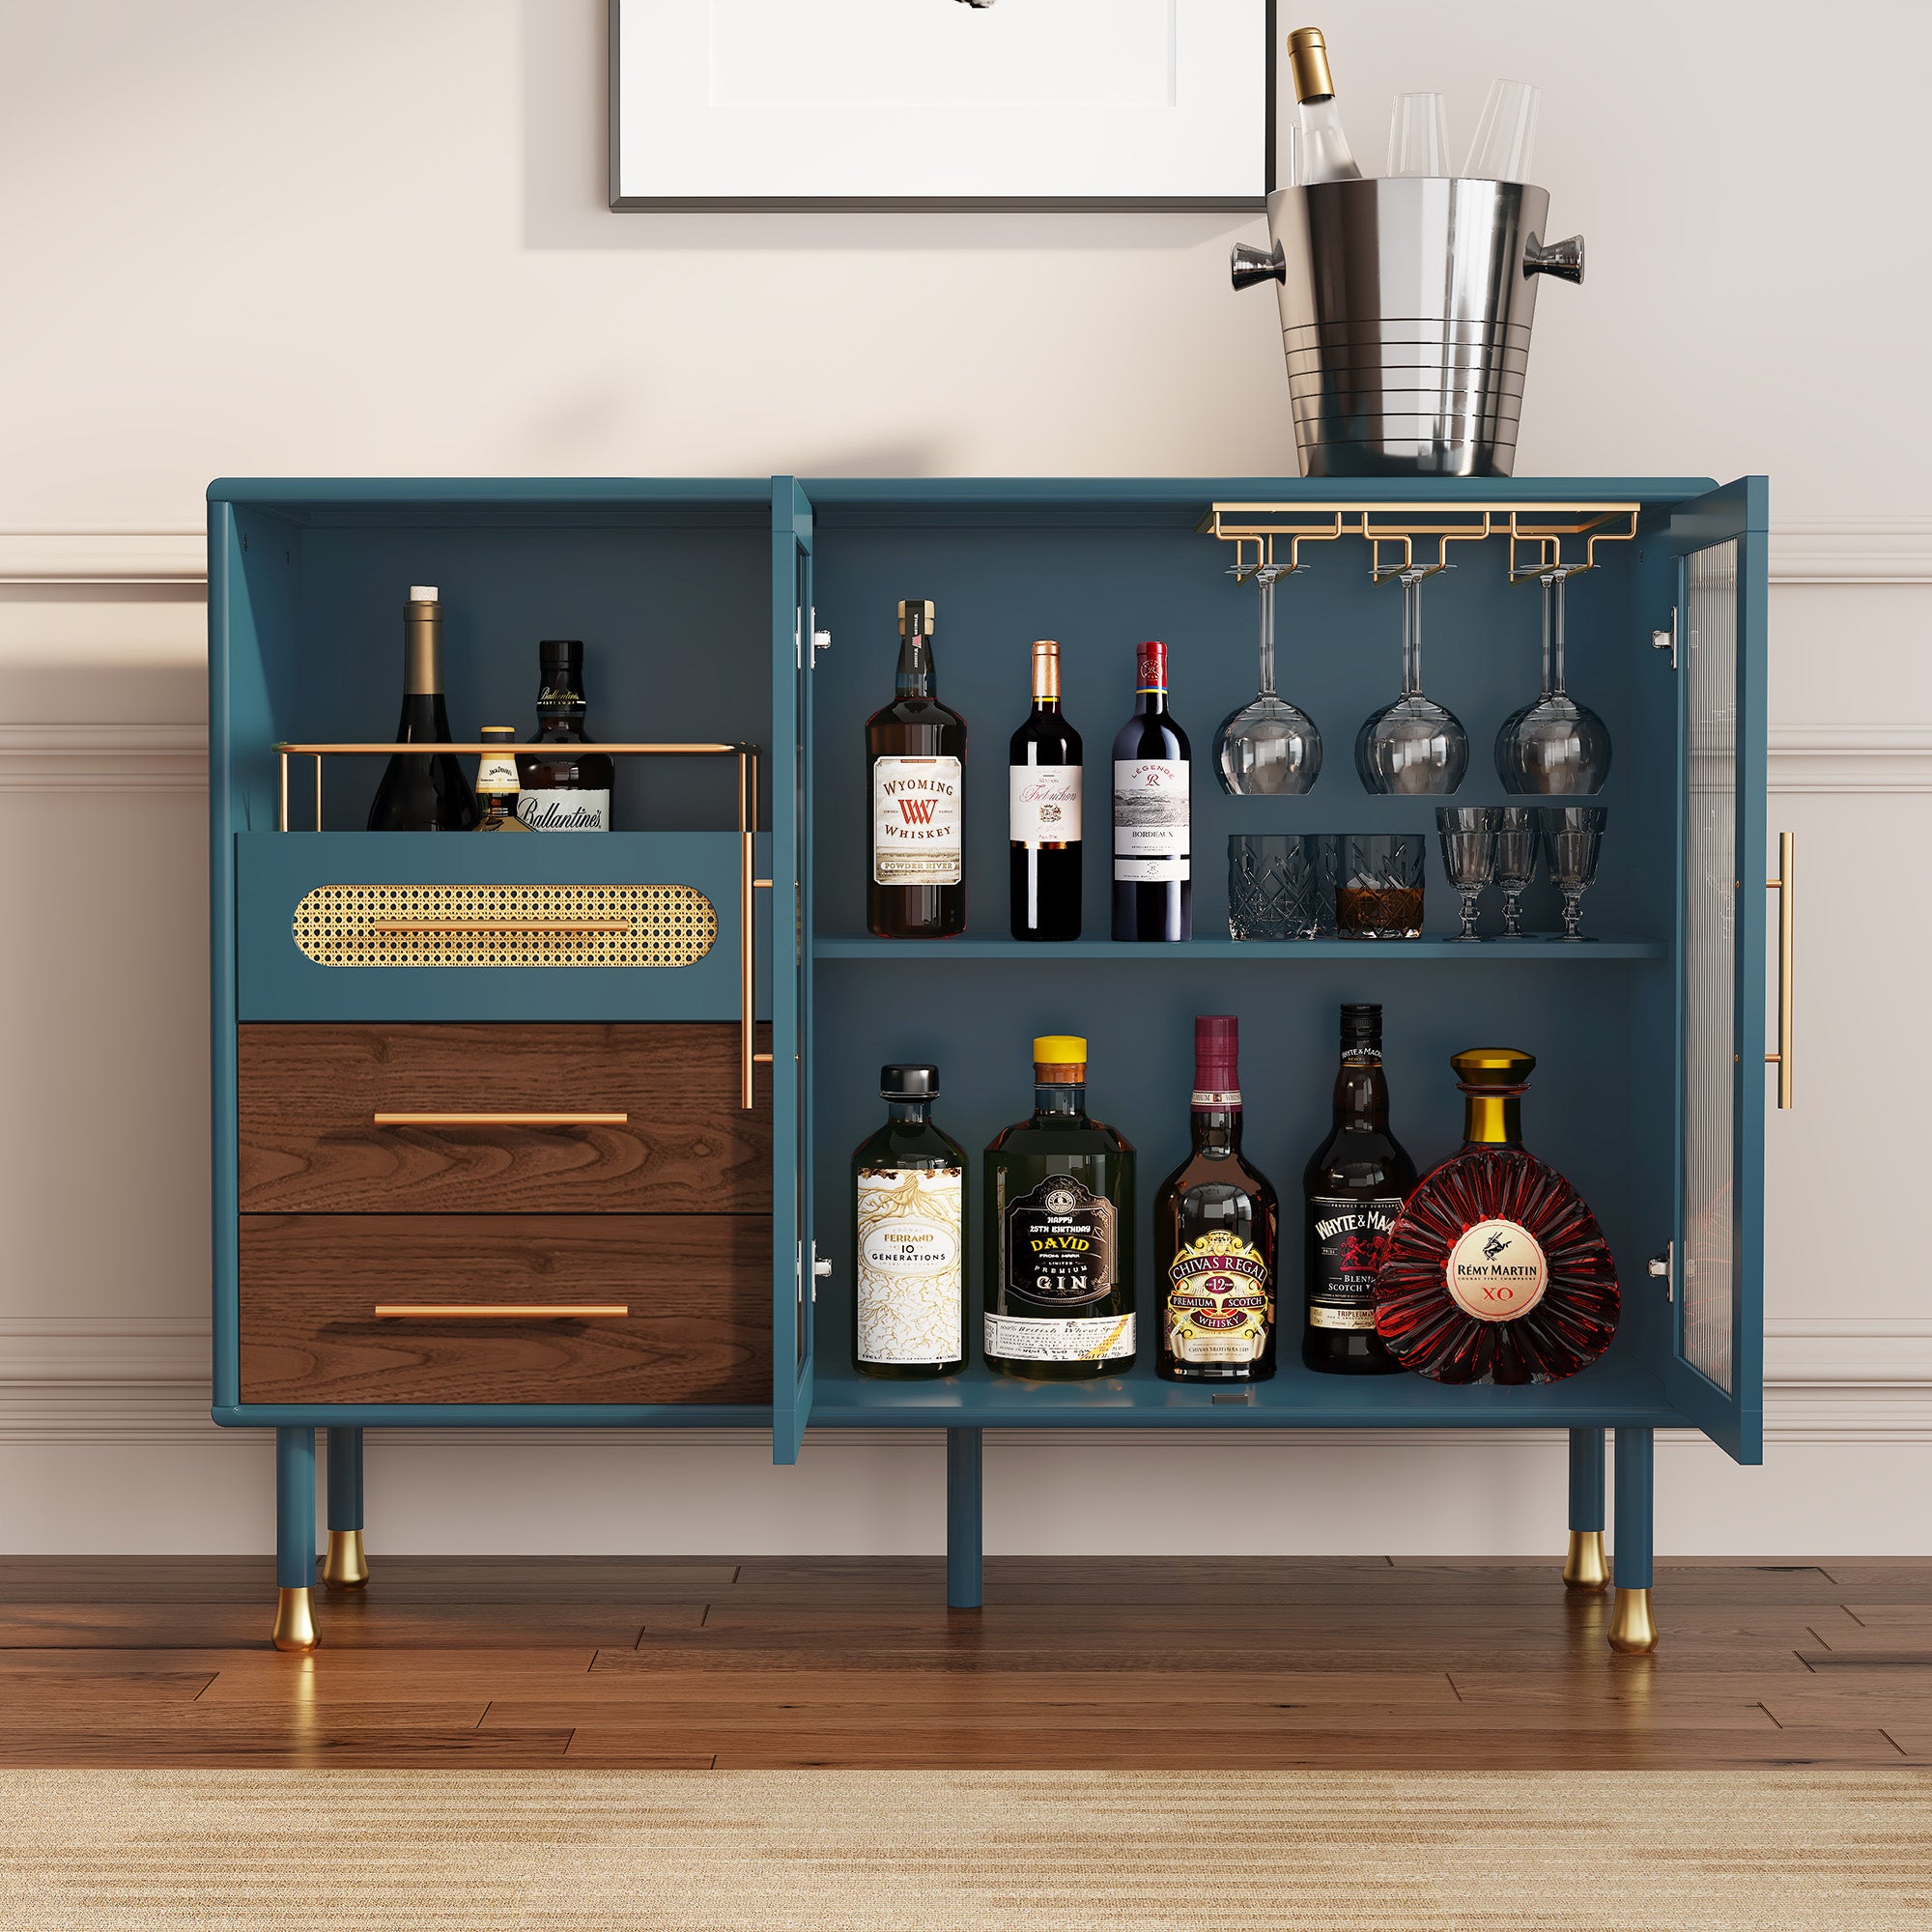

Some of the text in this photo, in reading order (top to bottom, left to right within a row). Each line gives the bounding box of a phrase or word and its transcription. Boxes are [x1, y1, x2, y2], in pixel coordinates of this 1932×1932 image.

[883, 779, 953, 796] WYOMING
[518, 796, 601, 829] Ballantine's
[885, 824, 951, 839] WHISKEY
[1051, 1225, 1091, 1234] BIRTHDAY
[1315, 1214, 1358, 1240] WHYTE
[884, 1234, 934, 1242] FERRAND
[1030, 1236, 1090, 1252] DAVID
[1034, 1264, 1088, 1274] PREMIUM
[1173, 1257, 1264, 1282] CHIVAS REGAL
[1458, 1264, 1537, 1276] RÉMY MARTIN
[1036, 1275, 1088, 1290] GIN
[1211, 1278, 1226, 1291] 12
[1328, 1283, 1363, 1292] SCOTCH
[1173, 1296, 1262, 1307] PREMIUM SCOTCH
[1480, 1287, 1514, 1302] XO
[1199, 1315, 1239, 1328] WHISKY
